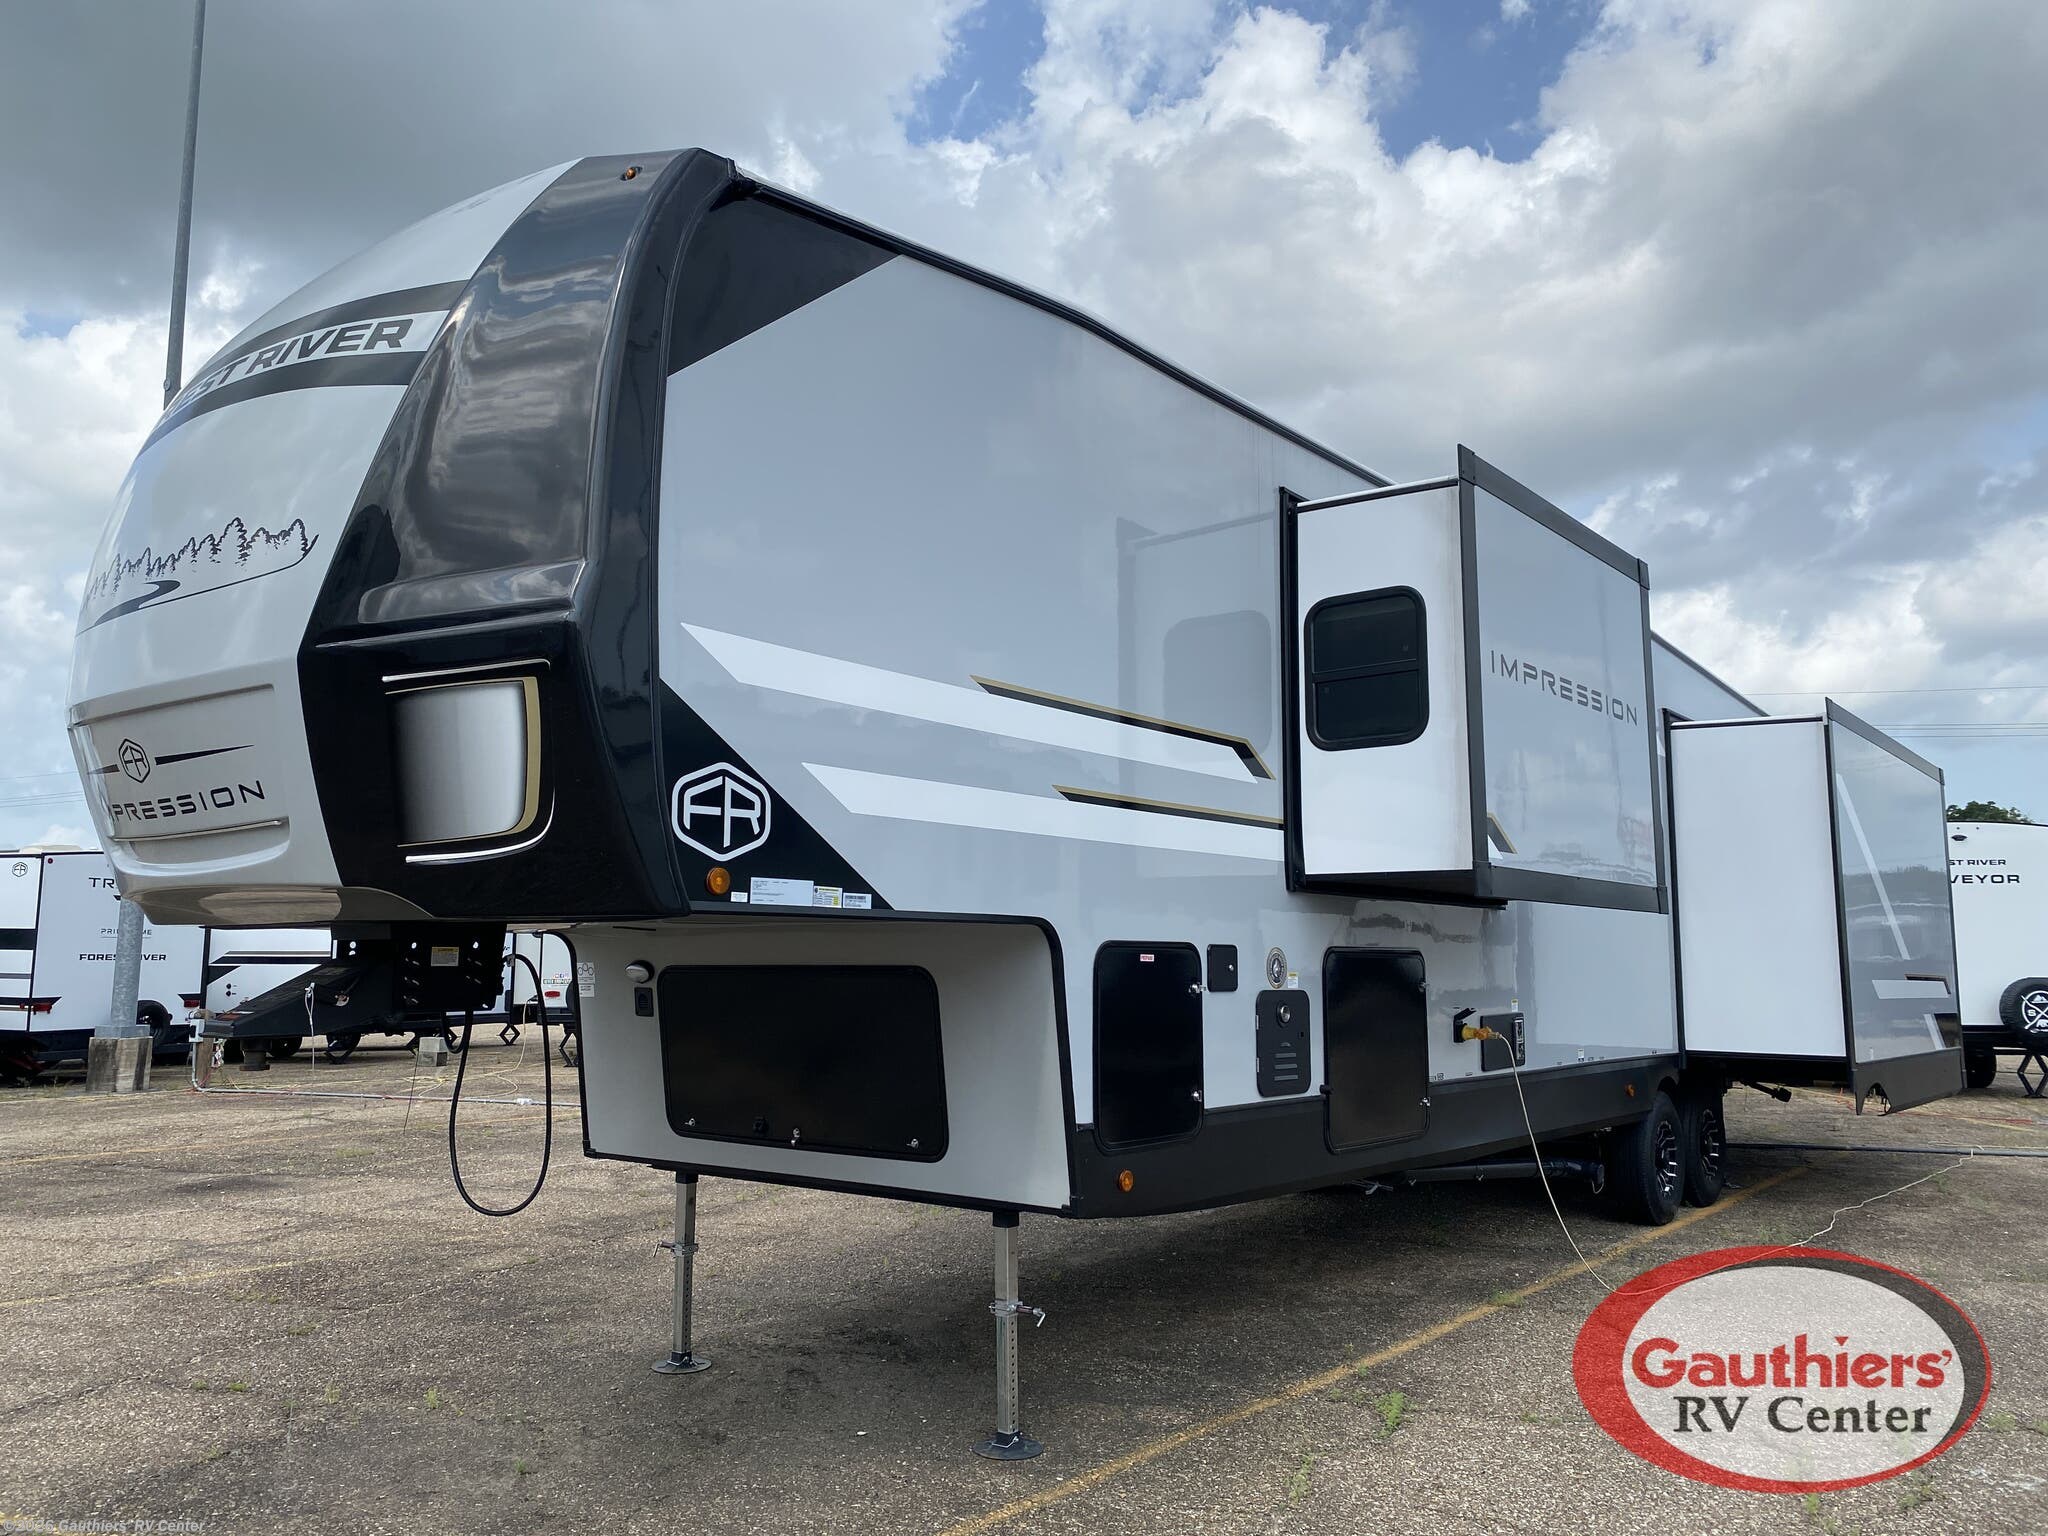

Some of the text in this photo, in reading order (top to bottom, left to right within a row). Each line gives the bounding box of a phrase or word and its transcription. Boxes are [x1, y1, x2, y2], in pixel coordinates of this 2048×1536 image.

[245, 319, 413, 375] RIVER
[1491, 650, 1638, 725] IMPRESSION
[1950, 874, 2020, 884] VEYOR
